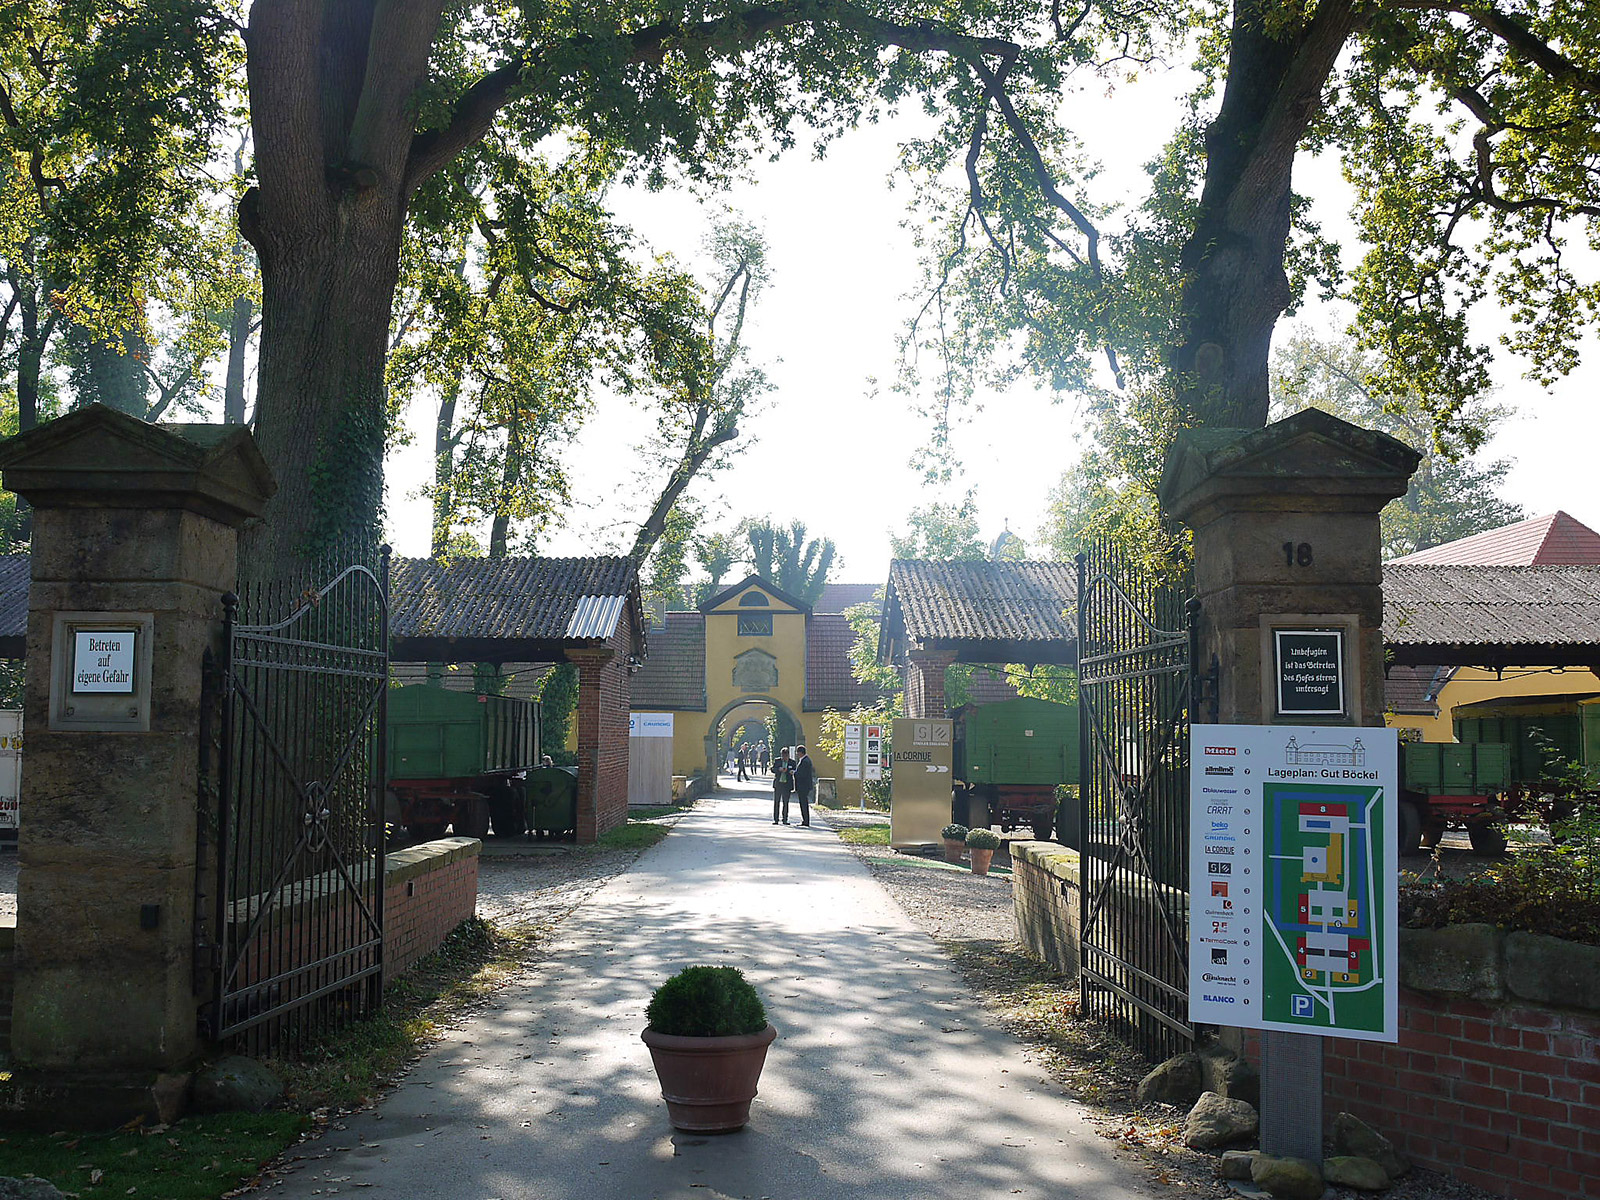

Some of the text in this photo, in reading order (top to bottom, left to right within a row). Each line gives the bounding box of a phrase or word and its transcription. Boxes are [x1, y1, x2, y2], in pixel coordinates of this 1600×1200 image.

[1282, 541, 1313, 567] 18
[89, 637, 120, 652] Betreten
[97, 654, 111, 667] auf
[1294, 661, 1306, 669] das
[1306, 661, 1336, 670] Betreten
[77, 669, 129, 686] eigene Gefahr
[1283, 673, 1337, 685] des Hofes streng
[903, 751, 932, 761] CORNUE
[1205, 747, 1235, 755] Miele
[1268, 767, 1378, 780] Lageplan: Gut Böckel
[1206, 806, 1233, 815] CARAT
[1203, 994, 1235, 1003] BLANCO
[1295, 997, 1309, 1015] P
